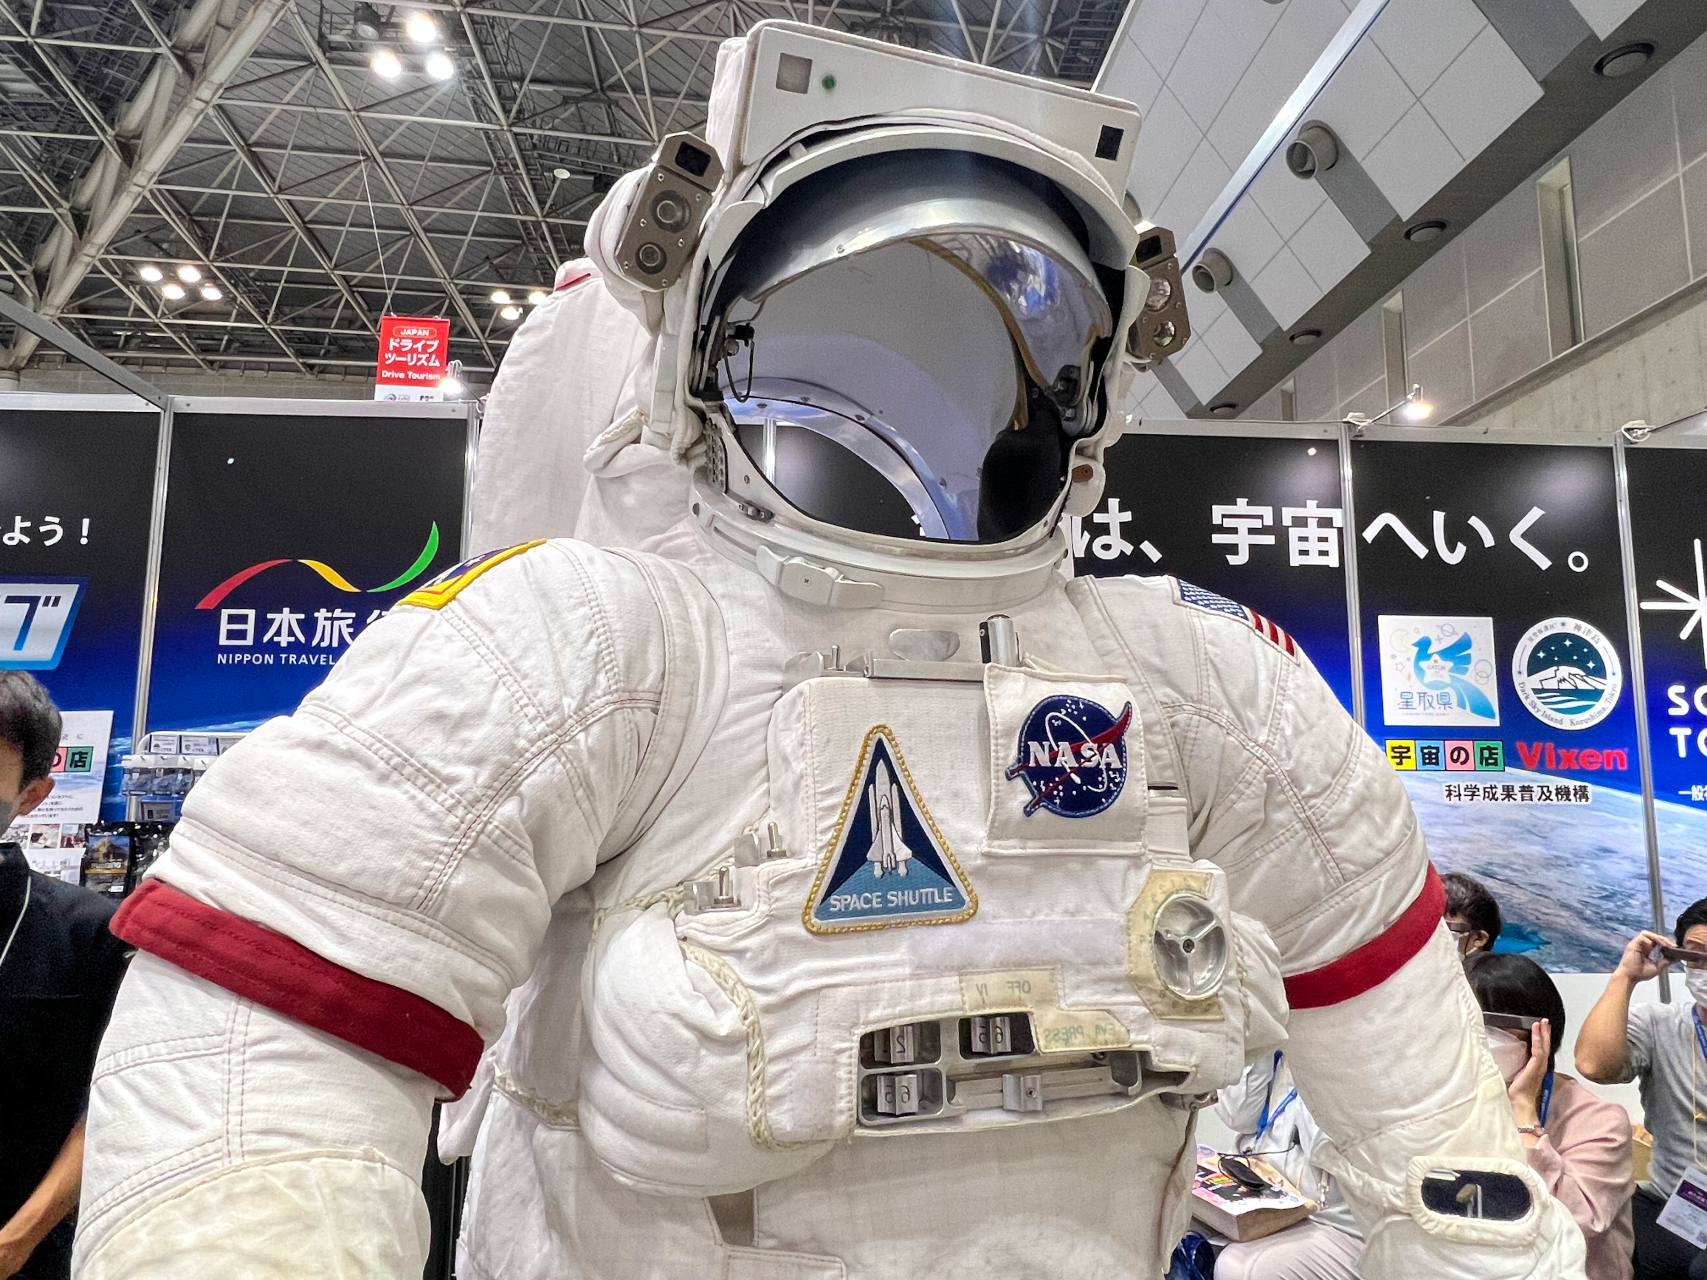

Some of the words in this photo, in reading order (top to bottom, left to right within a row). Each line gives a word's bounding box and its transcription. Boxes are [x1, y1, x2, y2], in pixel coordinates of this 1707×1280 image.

[400, 328, 430, 337] JAPAN
[388, 337, 440, 353] ドライブ
[384, 352, 440, 367] ツーリズム
[381, 369, 405, 379] Drive
[407, 371, 440, 380] Tourism
[218, 607, 389, 648] 日本旅
[217, 653, 274, 665] NIPPON
[279, 653, 336, 666] TRAVEL
[1396, 691, 1454, 711] 星取県
[1518, 681, 1530, 701] Dark
[1528, 699, 1541, 714] Sky
[1540, 708, 1564, 725] Island
[1027, 740, 1123, 769] NASA
[1390, 744, 1500, 767] 宇宙の店
[1516, 741, 1629, 771] Vixen
[1444, 784, 1591, 803] 科学成果普及機構
[1677, 785, 1707, 802] 一般
[829, 891, 883, 912] SPACE
[887, 886, 954, 907] SHUTTLE
